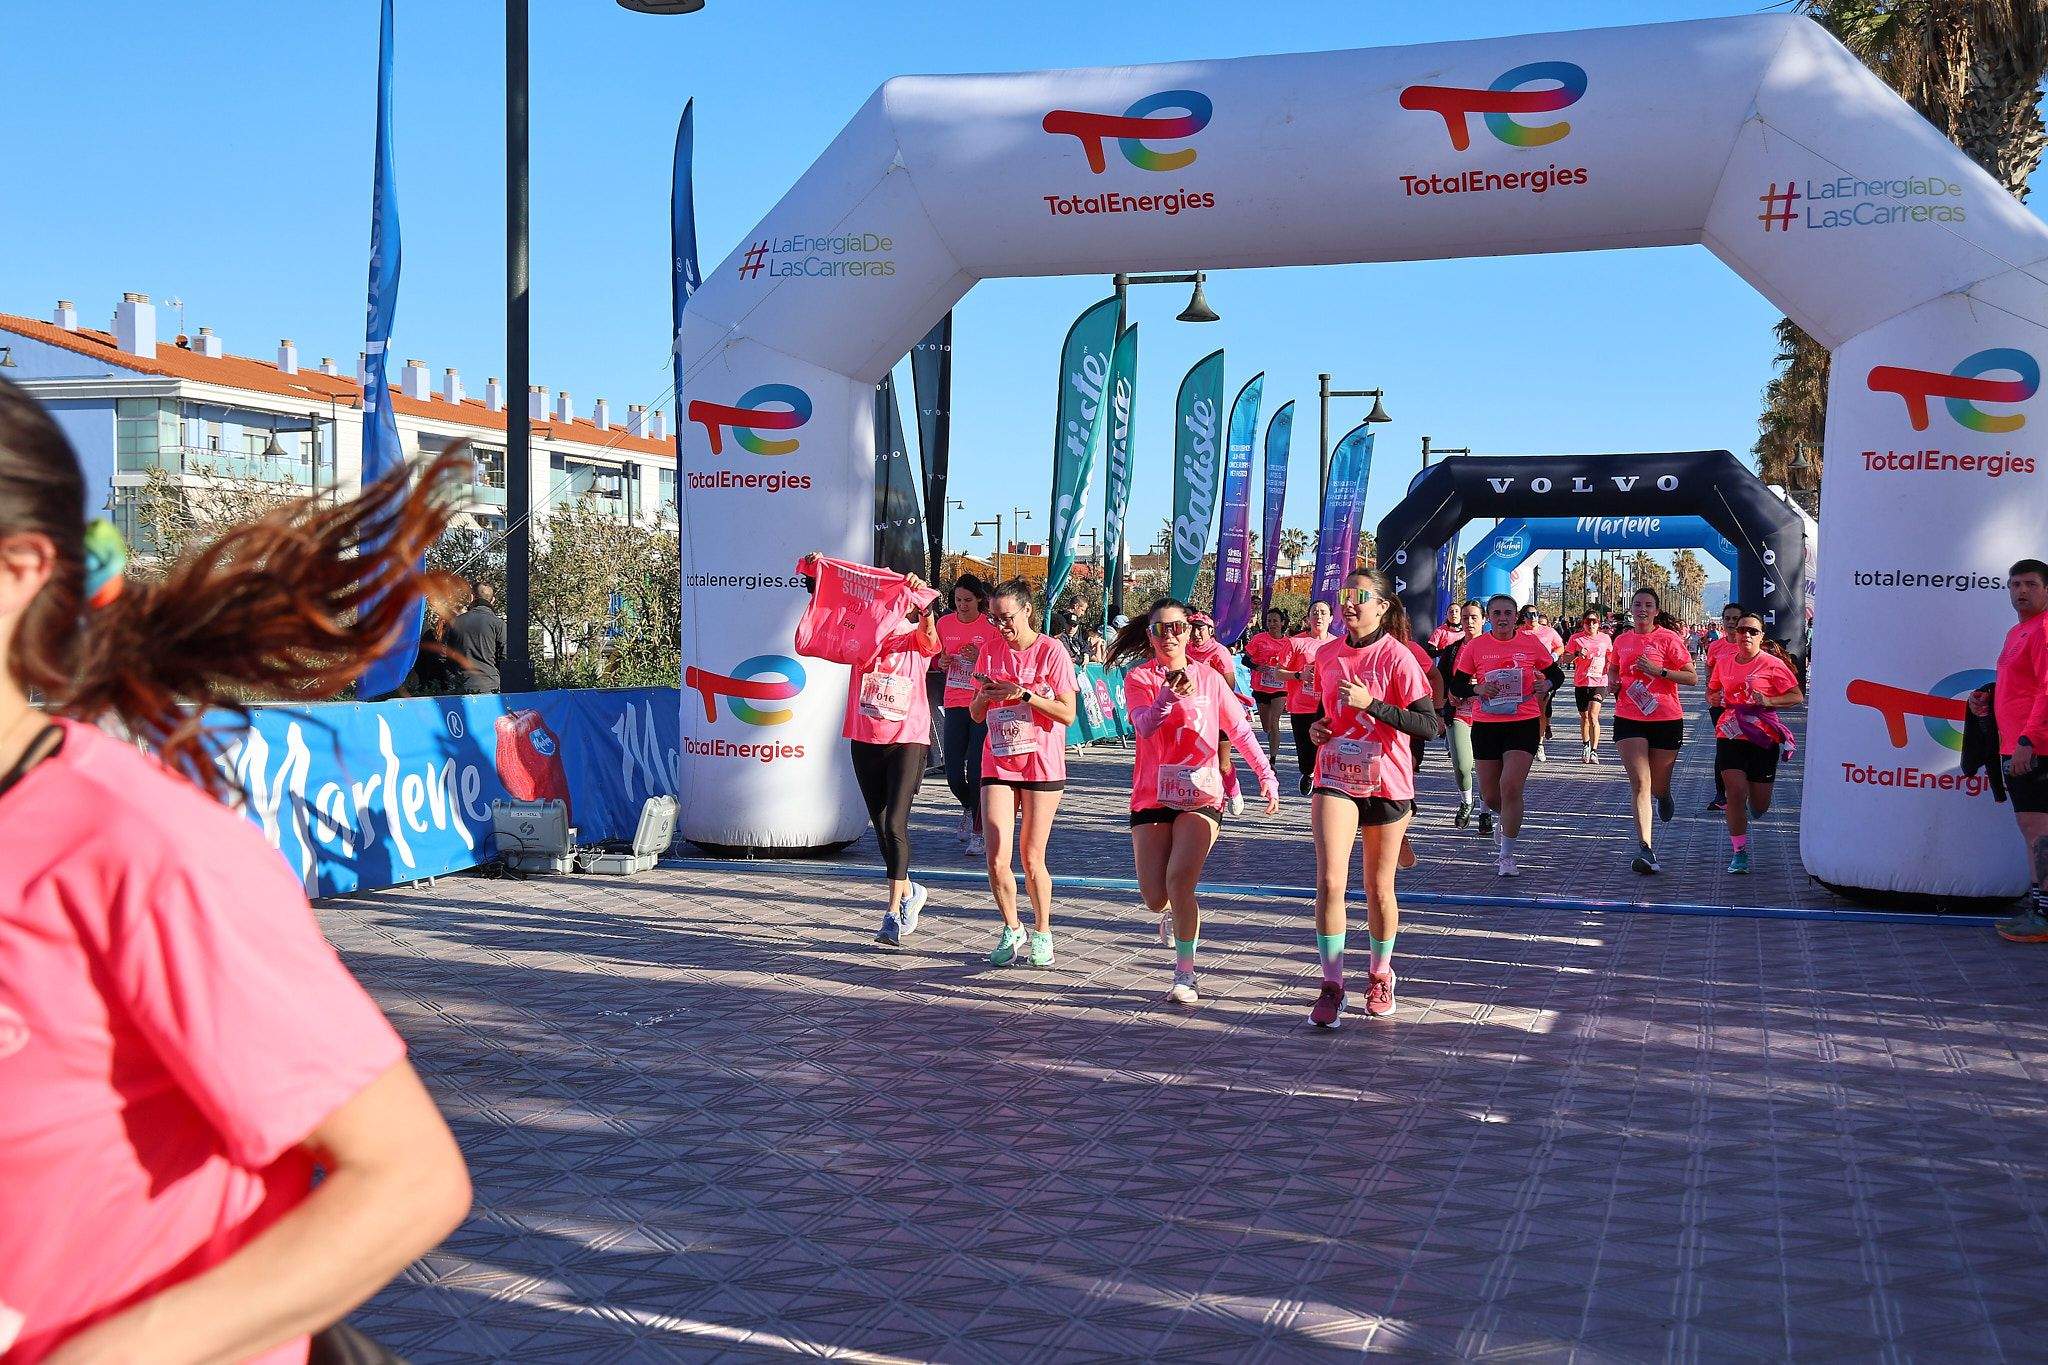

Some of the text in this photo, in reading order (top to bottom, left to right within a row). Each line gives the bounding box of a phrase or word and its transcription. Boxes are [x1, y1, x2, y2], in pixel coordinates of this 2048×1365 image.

[1400, 164, 1588, 197] TotalEnergies
[1043, 188, 1215, 216] TotalEnergies
[1806, 201, 1967, 230] LasCarreras
[768, 255, 896, 279] LasCarreras
[1862, 450, 2036, 478] TotalEnergies
[687, 470, 812, 493] TotalEnergies
[1174, 397, 1217, 566] Batiste
[1486, 474, 1680, 494] VOLVO
[1576, 515, 1661, 544] Marlene
[686, 572, 809, 590] totalenergies.es
[876, 692, 895, 703] 016
[684, 736, 805, 763] TotalEnergies
[1340, 762, 1362, 774] 016
[214, 713, 492, 899] Marlene
[1178, 788, 1200, 798] 016
